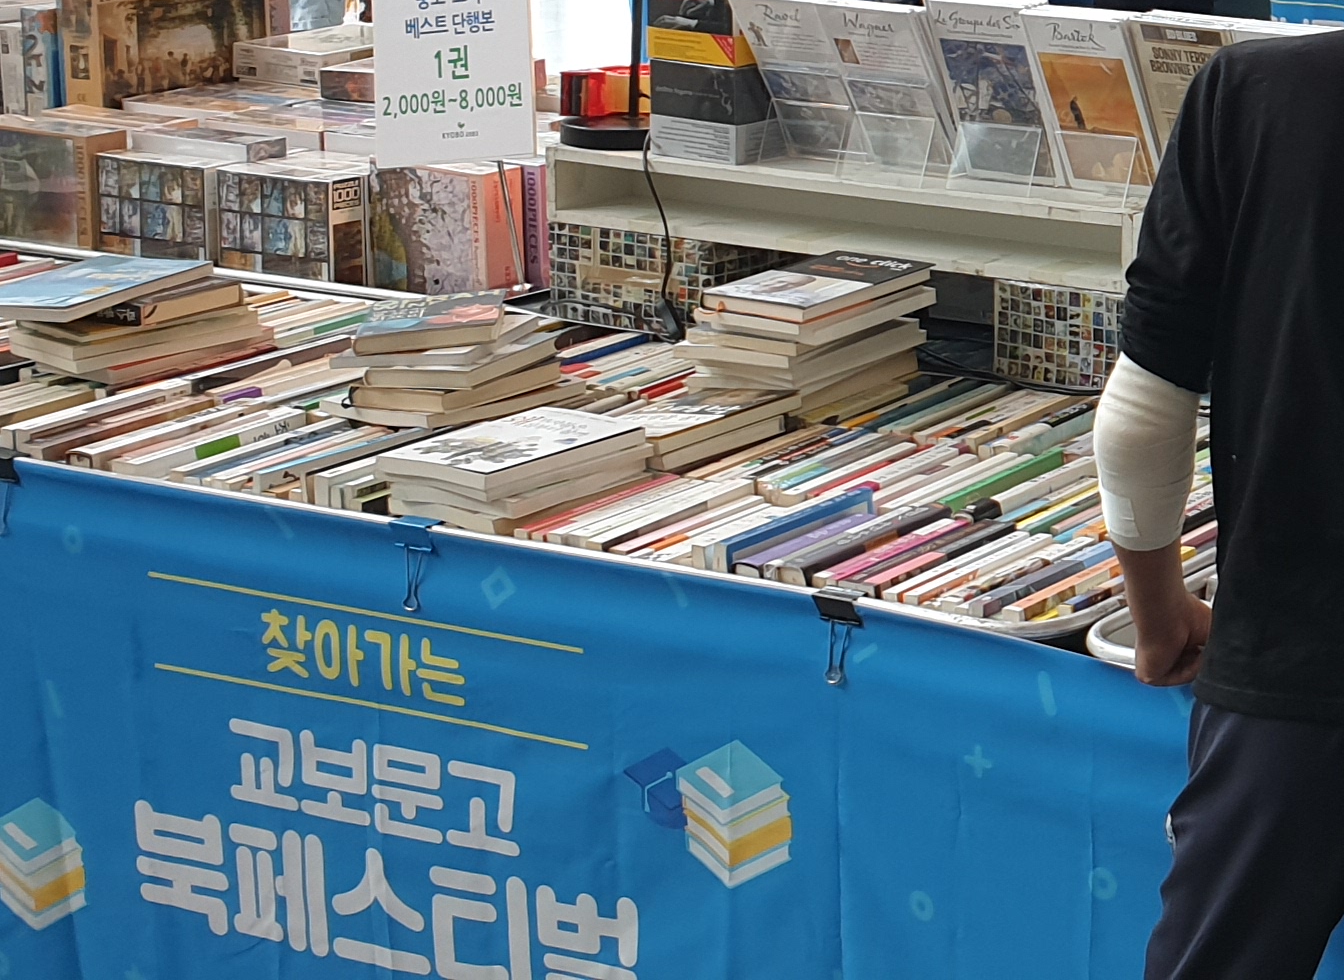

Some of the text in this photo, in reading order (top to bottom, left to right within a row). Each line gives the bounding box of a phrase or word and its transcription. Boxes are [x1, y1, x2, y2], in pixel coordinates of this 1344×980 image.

[405, 9, 496, 39] 베스트 단행본
[843, 12, 896, 39] Wagner
[433, 44, 470, 81] 1권
[1150, 60, 1193, 76] BROWNIE
[1151, 47, 1183, 63] SONNY
[382, 81, 524, 120] 2,000원~8,000원
[333, 188, 361, 202] 1000
[836, 253, 869, 266] one
[259, 608, 467, 708] 찾아가는
[228, 715, 521, 859] 교보문고
[133, 799, 641, 980] 북페스티벌
